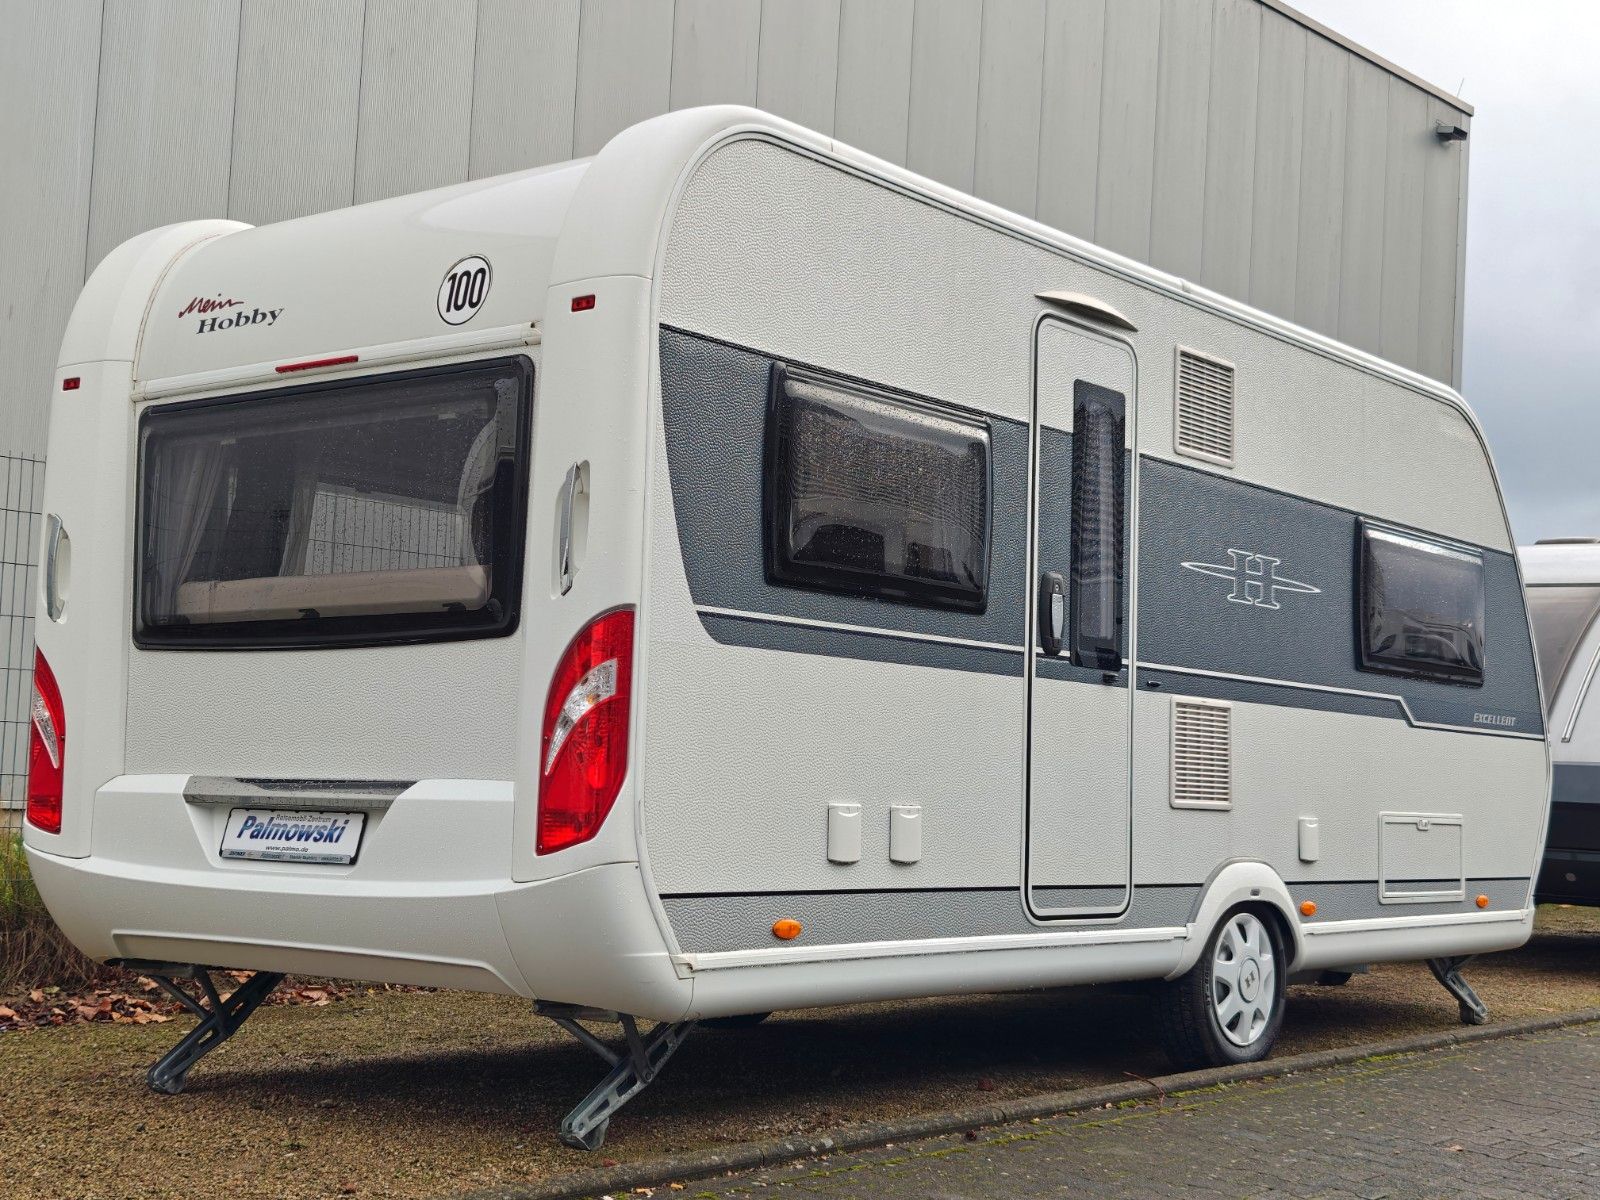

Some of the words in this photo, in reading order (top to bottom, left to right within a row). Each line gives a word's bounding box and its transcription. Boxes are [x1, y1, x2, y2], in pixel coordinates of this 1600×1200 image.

[446, 267, 487, 313] 100
[178, 293, 245, 319] Mein
[196, 307, 285, 335] Hobby
[1473, 712, 1516, 727] EXCELLENT
[236, 815, 350, 844] Palmowski
